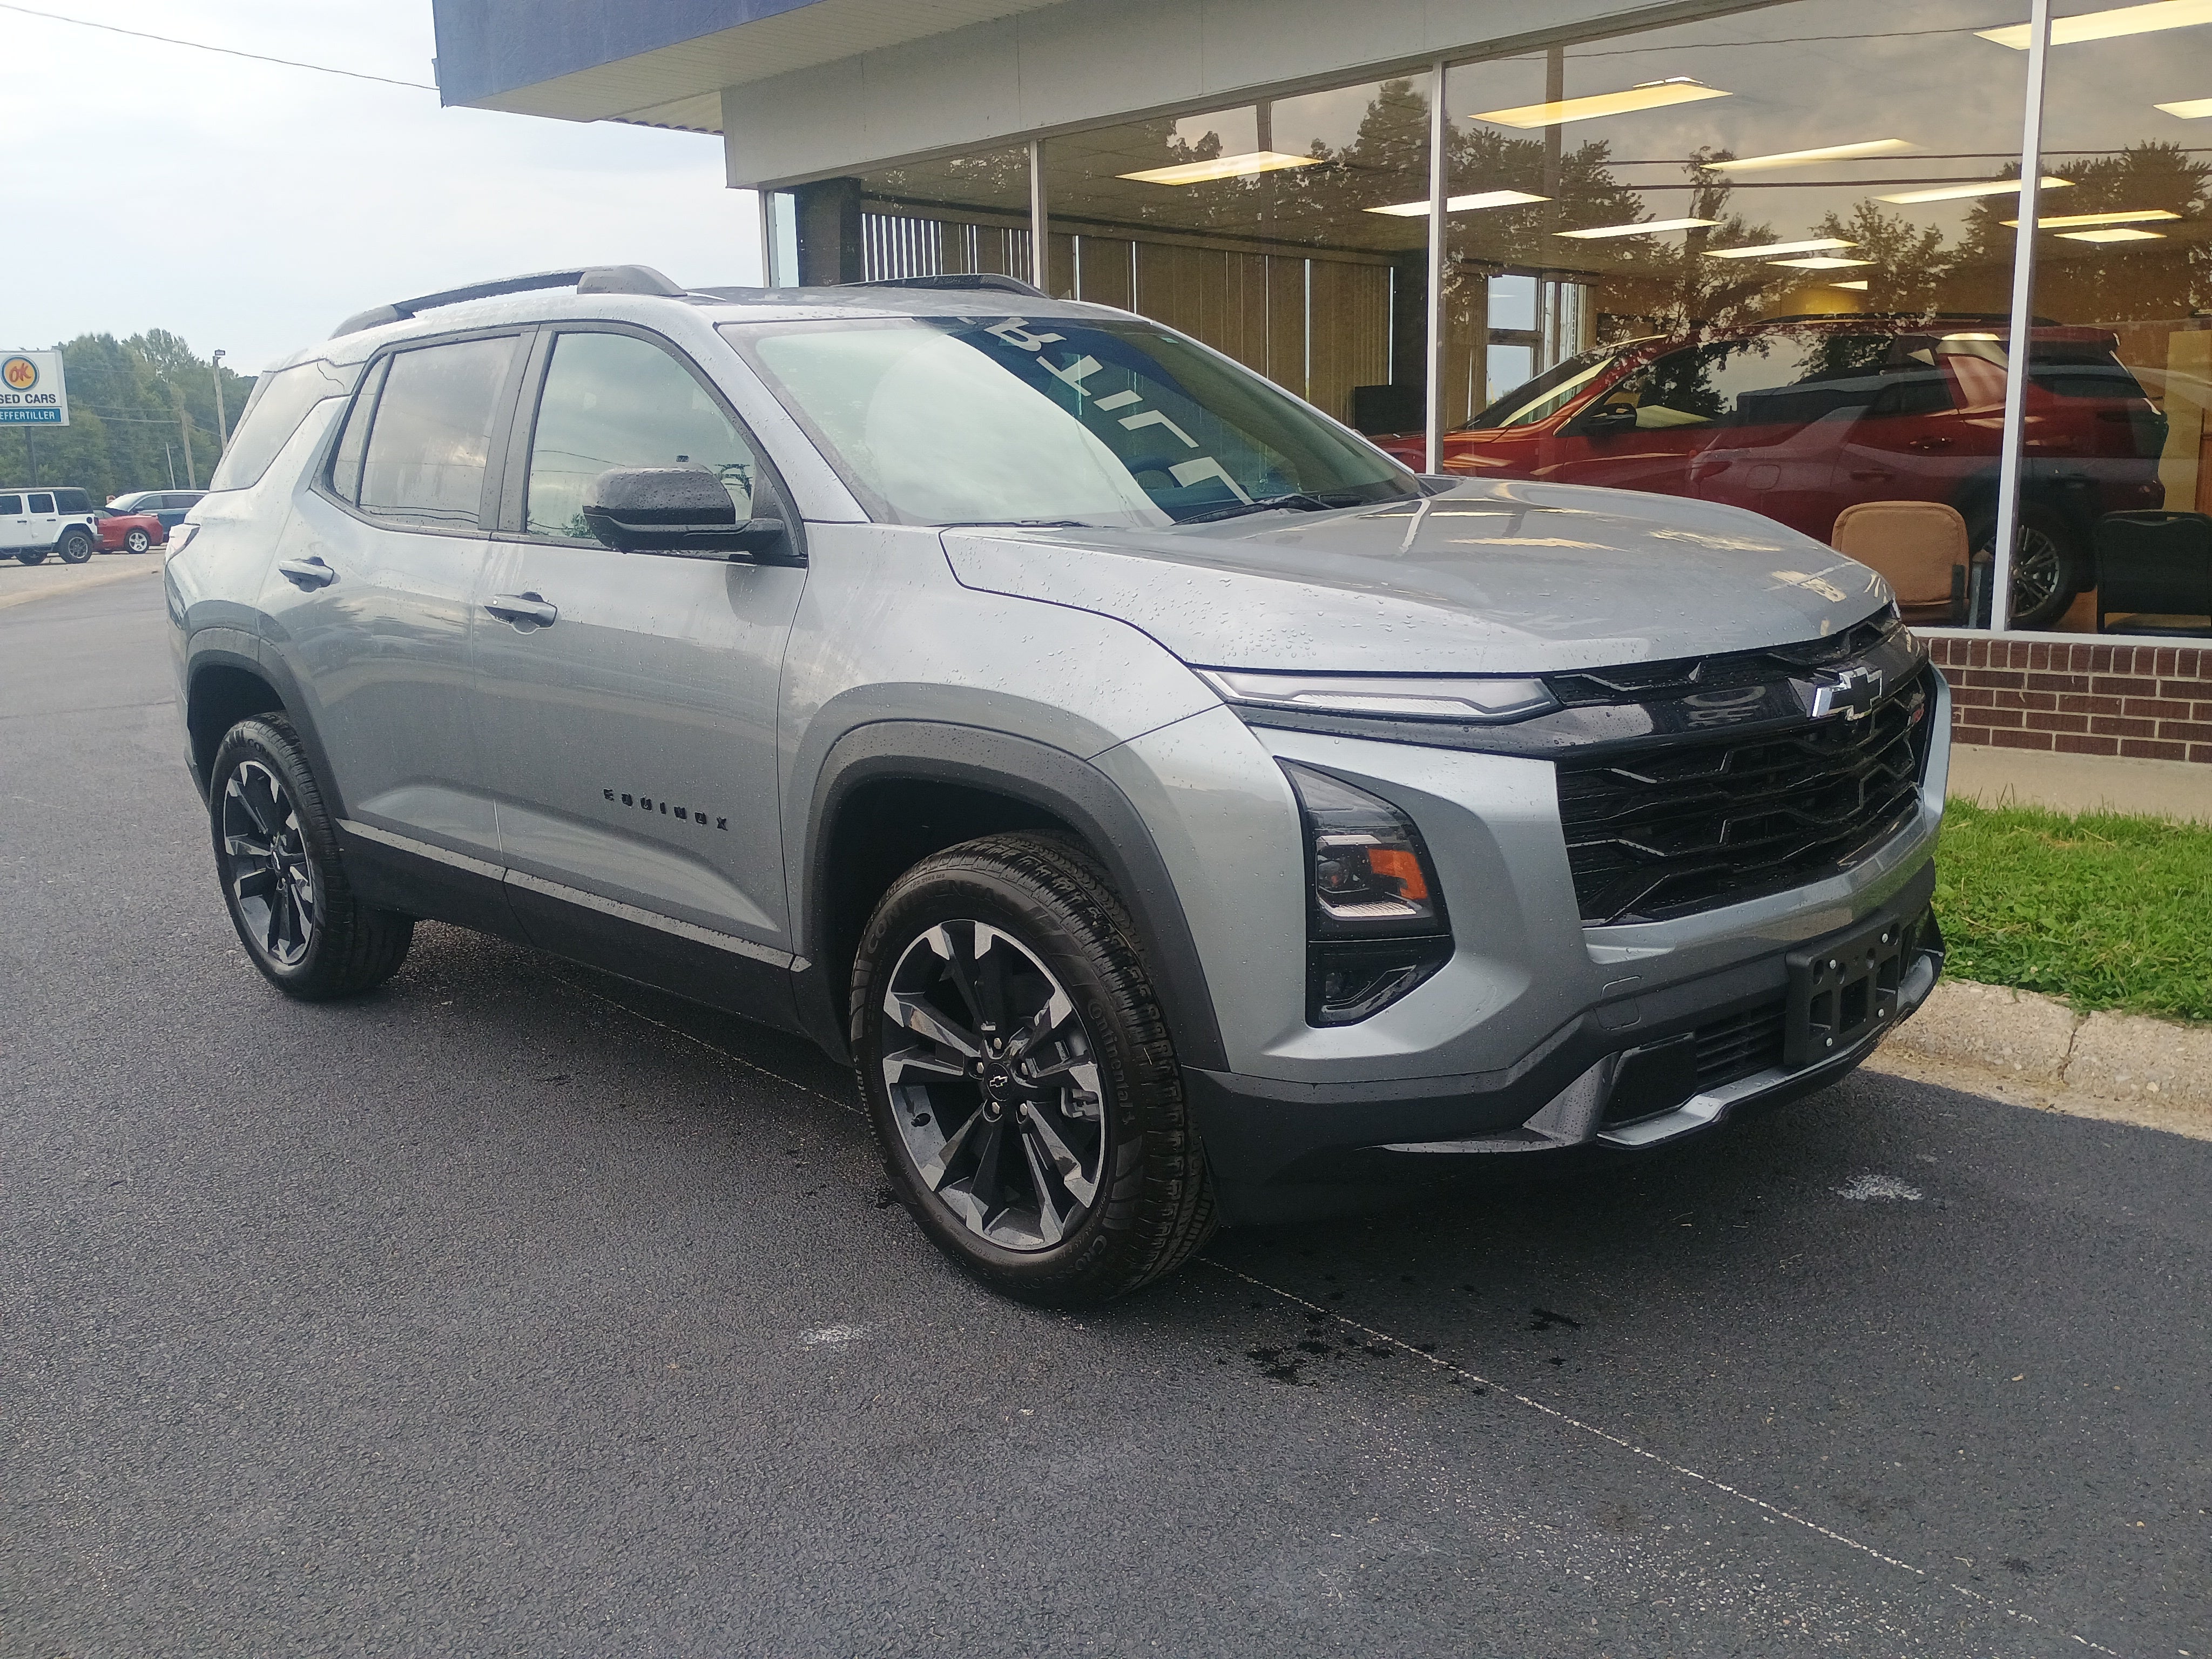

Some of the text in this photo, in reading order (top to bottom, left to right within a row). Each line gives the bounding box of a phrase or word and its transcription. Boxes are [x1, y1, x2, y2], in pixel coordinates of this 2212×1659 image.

[9, 362, 32, 383] OK
[24, 394, 56, 404] CARS
[603, 788, 728, 831] EQUINOX
[1088, 1002, 1134, 1107] Continental
